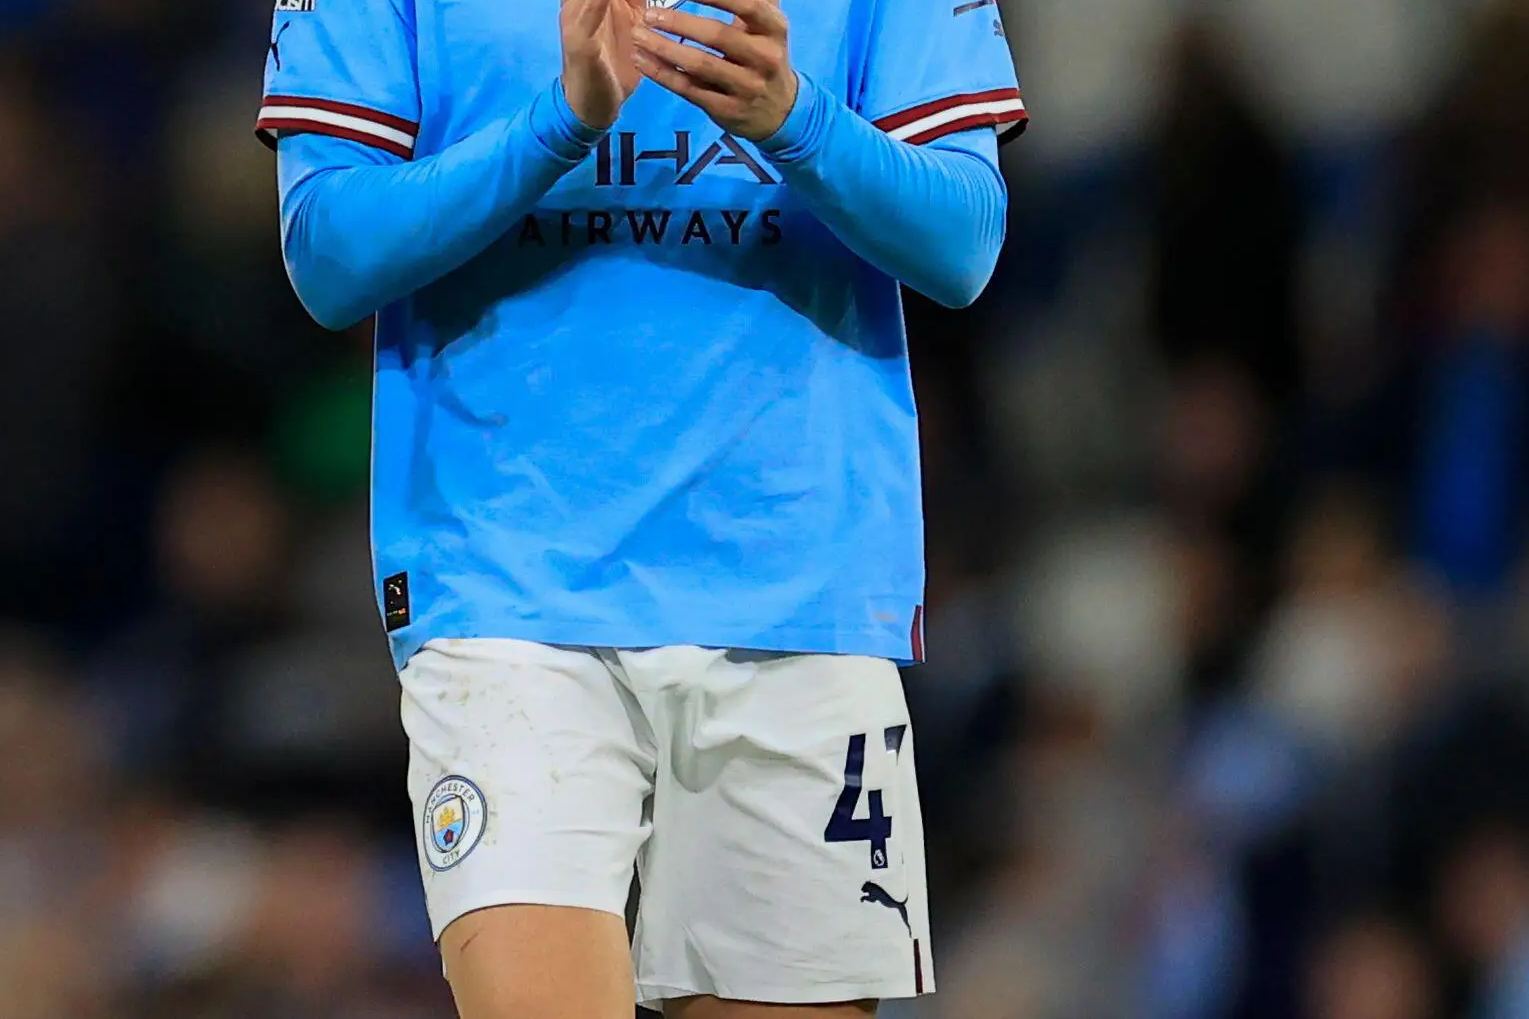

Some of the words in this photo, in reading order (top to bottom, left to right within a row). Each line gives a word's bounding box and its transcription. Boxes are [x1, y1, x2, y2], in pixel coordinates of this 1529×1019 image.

[648, 0, 667, 8] ITY
[595, 130, 786, 186] IHA
[517, 209, 783, 245] AIRWAYS
[442, 848, 461, 865] CITY
